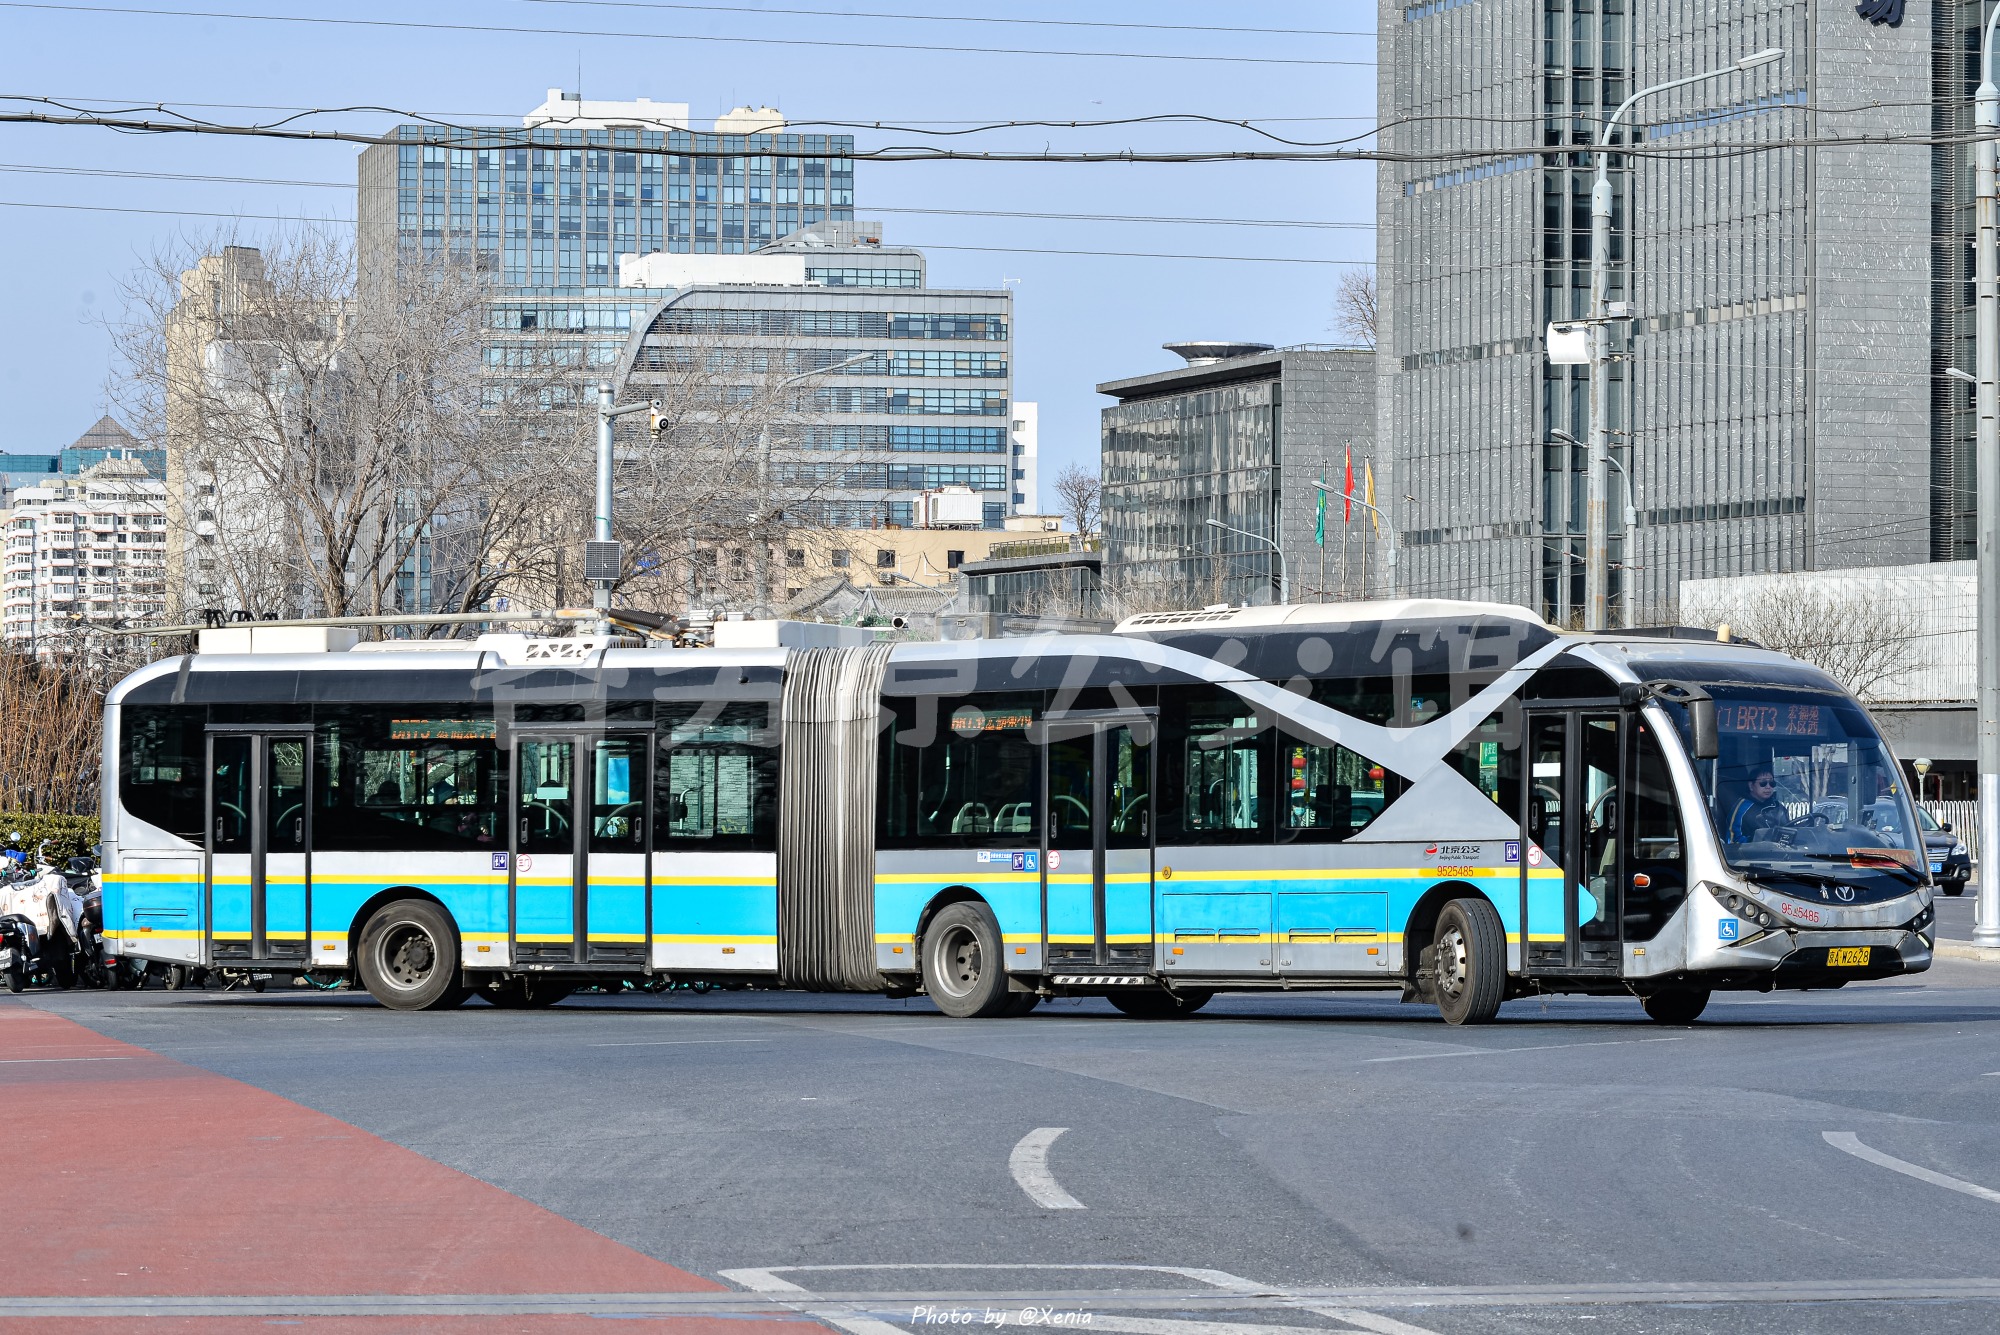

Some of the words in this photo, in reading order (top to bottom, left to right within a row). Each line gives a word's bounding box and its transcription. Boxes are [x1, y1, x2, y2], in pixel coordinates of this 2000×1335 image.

[1736, 705, 1778, 731] BRT3
[1785, 720, 1820, 735] 小区西
[1440, 845, 1481, 854] 北京公交
[1437, 865, 1474, 877] 9525485
